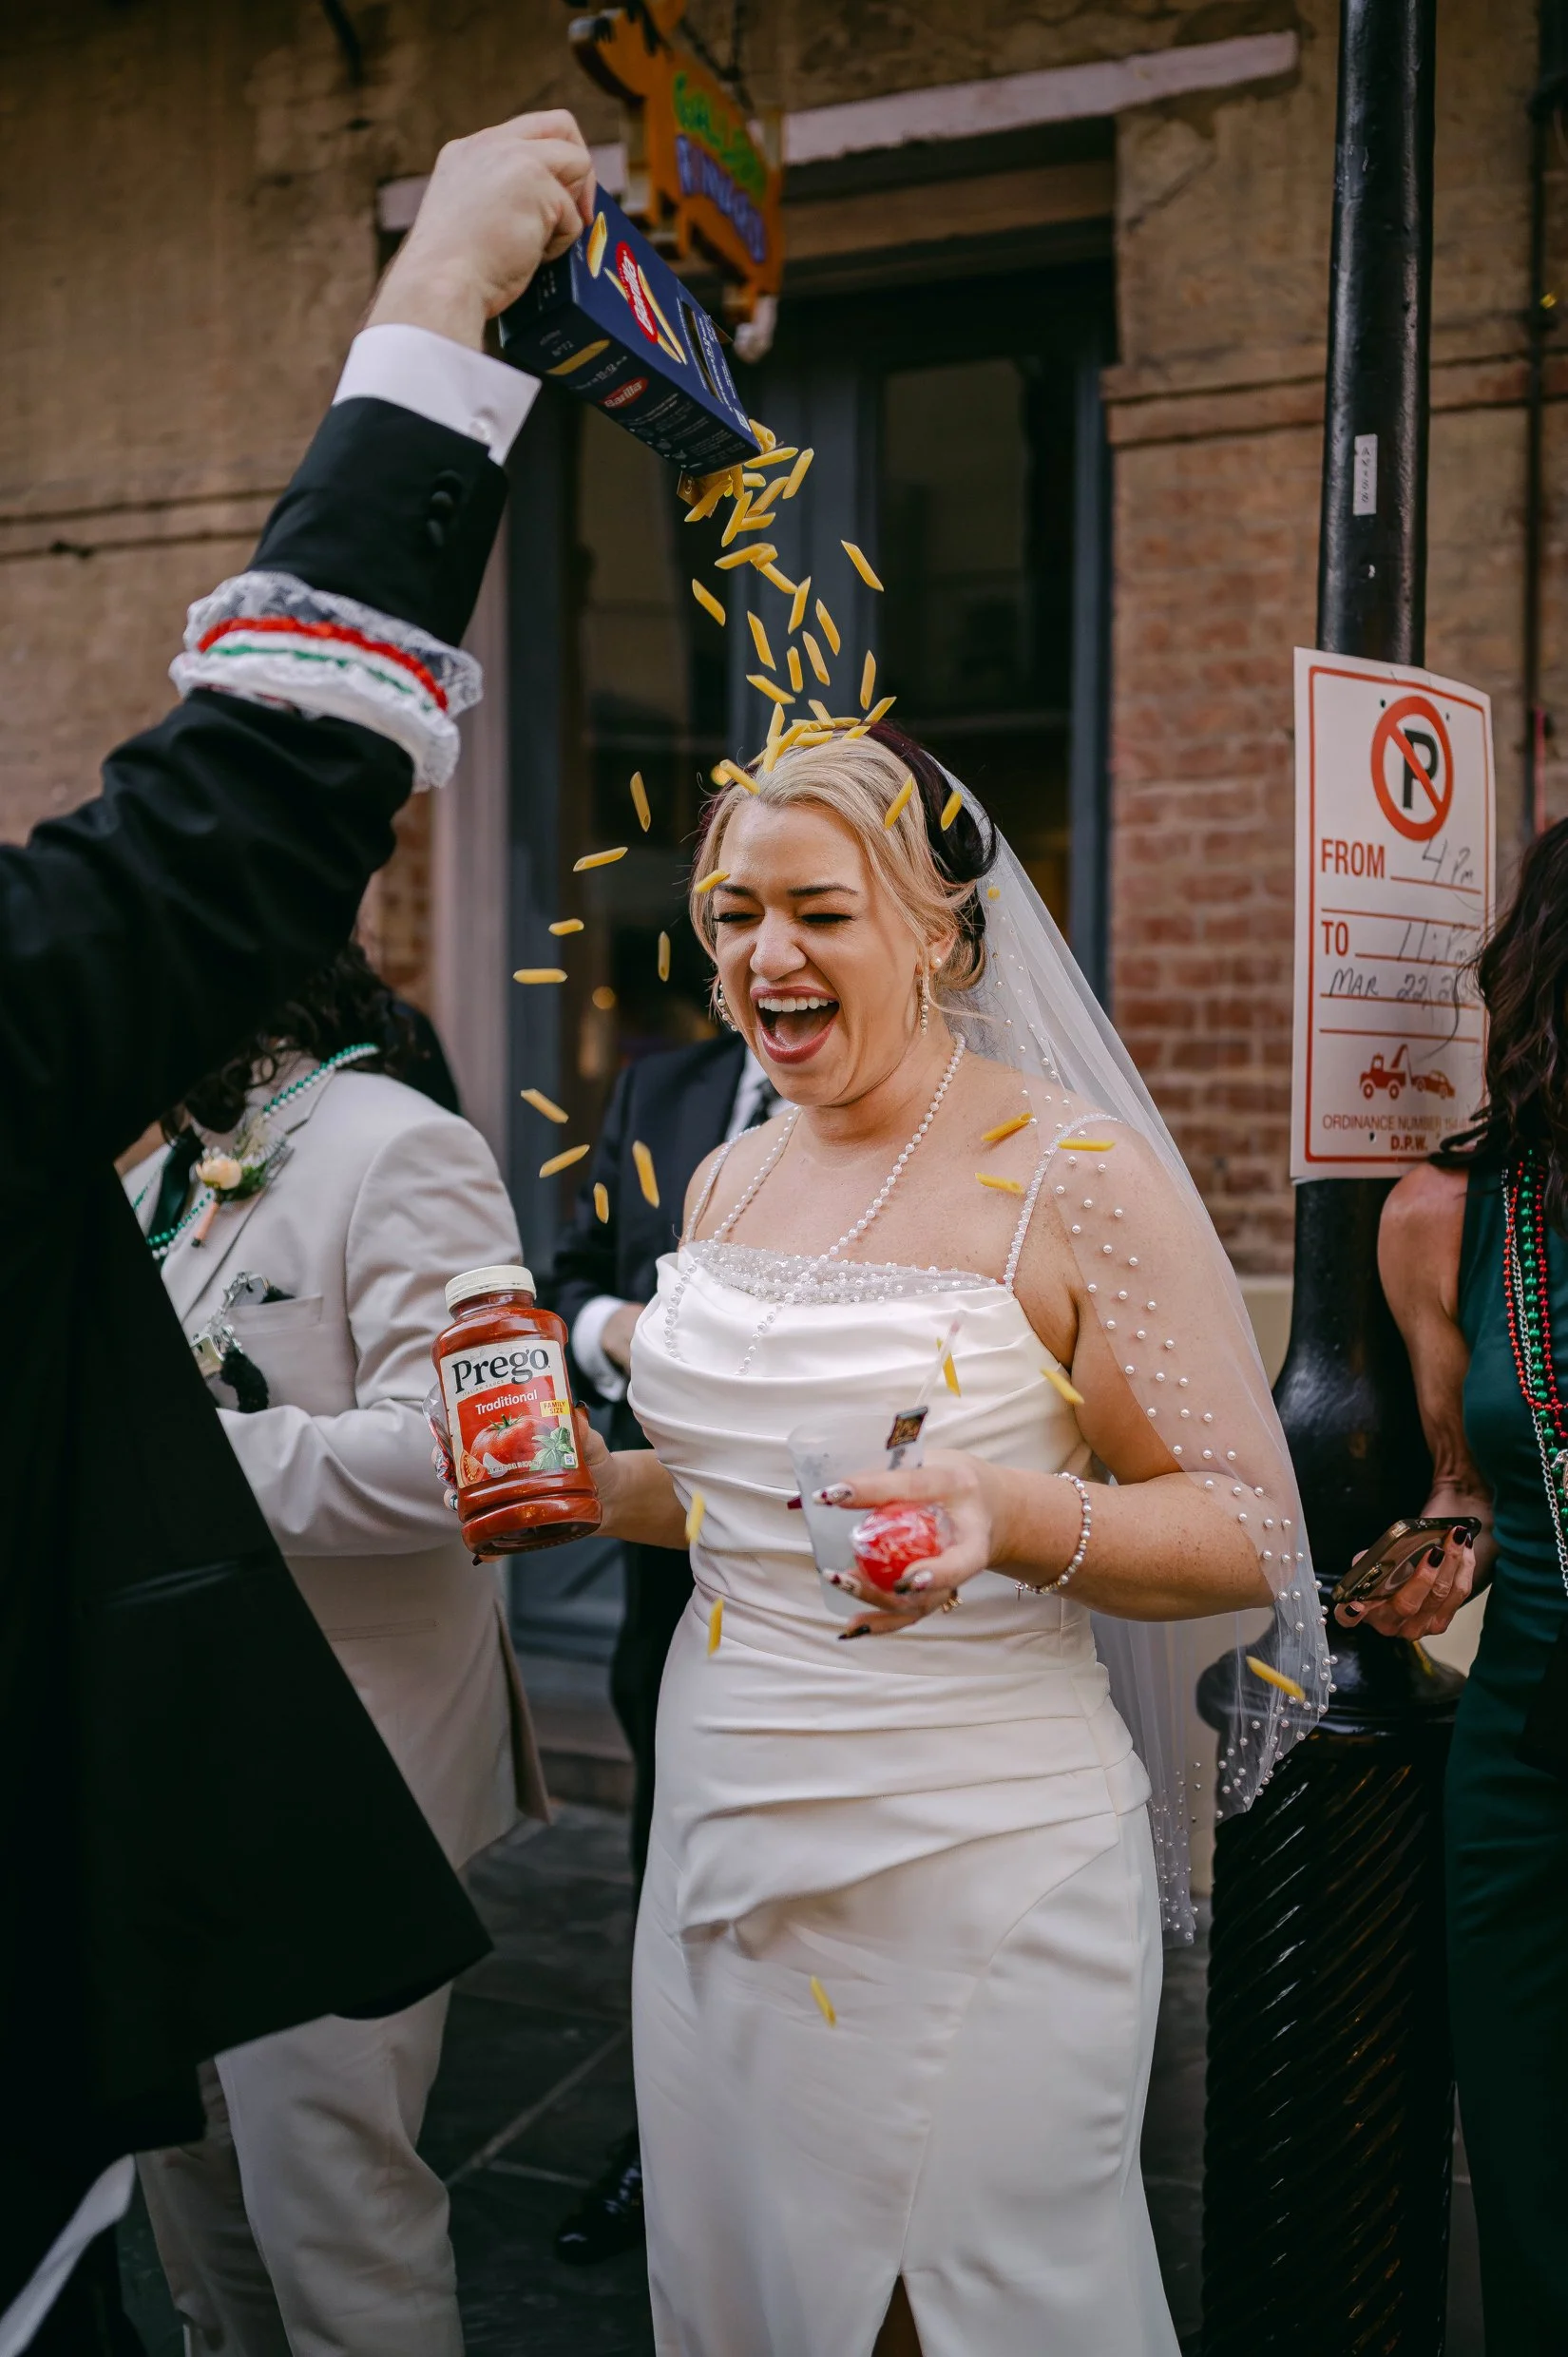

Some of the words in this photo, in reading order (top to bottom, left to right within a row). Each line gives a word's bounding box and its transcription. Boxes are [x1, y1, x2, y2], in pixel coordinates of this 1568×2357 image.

[602, 380, 643, 409] Barilla
[1403, 728, 1439, 810] P
[1321, 839, 1385, 879] FROM
[1422, 837, 1448, 883] 4
[1321, 920, 1349, 956] TO
[1329, 967, 1379, 998] MAR
[1322, 1114, 1394, 1130] ORDINANCE
[1398, 1115, 1442, 1131] NUMBER
[1390, 1135, 1428, 1151] D.P.W.
[451, 1348, 549, 1394] Prego
[462, 1386, 484, 1397] ITALIAN
[485, 1379, 505, 1388] SAUCE
[475, 1389, 538, 1415] Traditional
